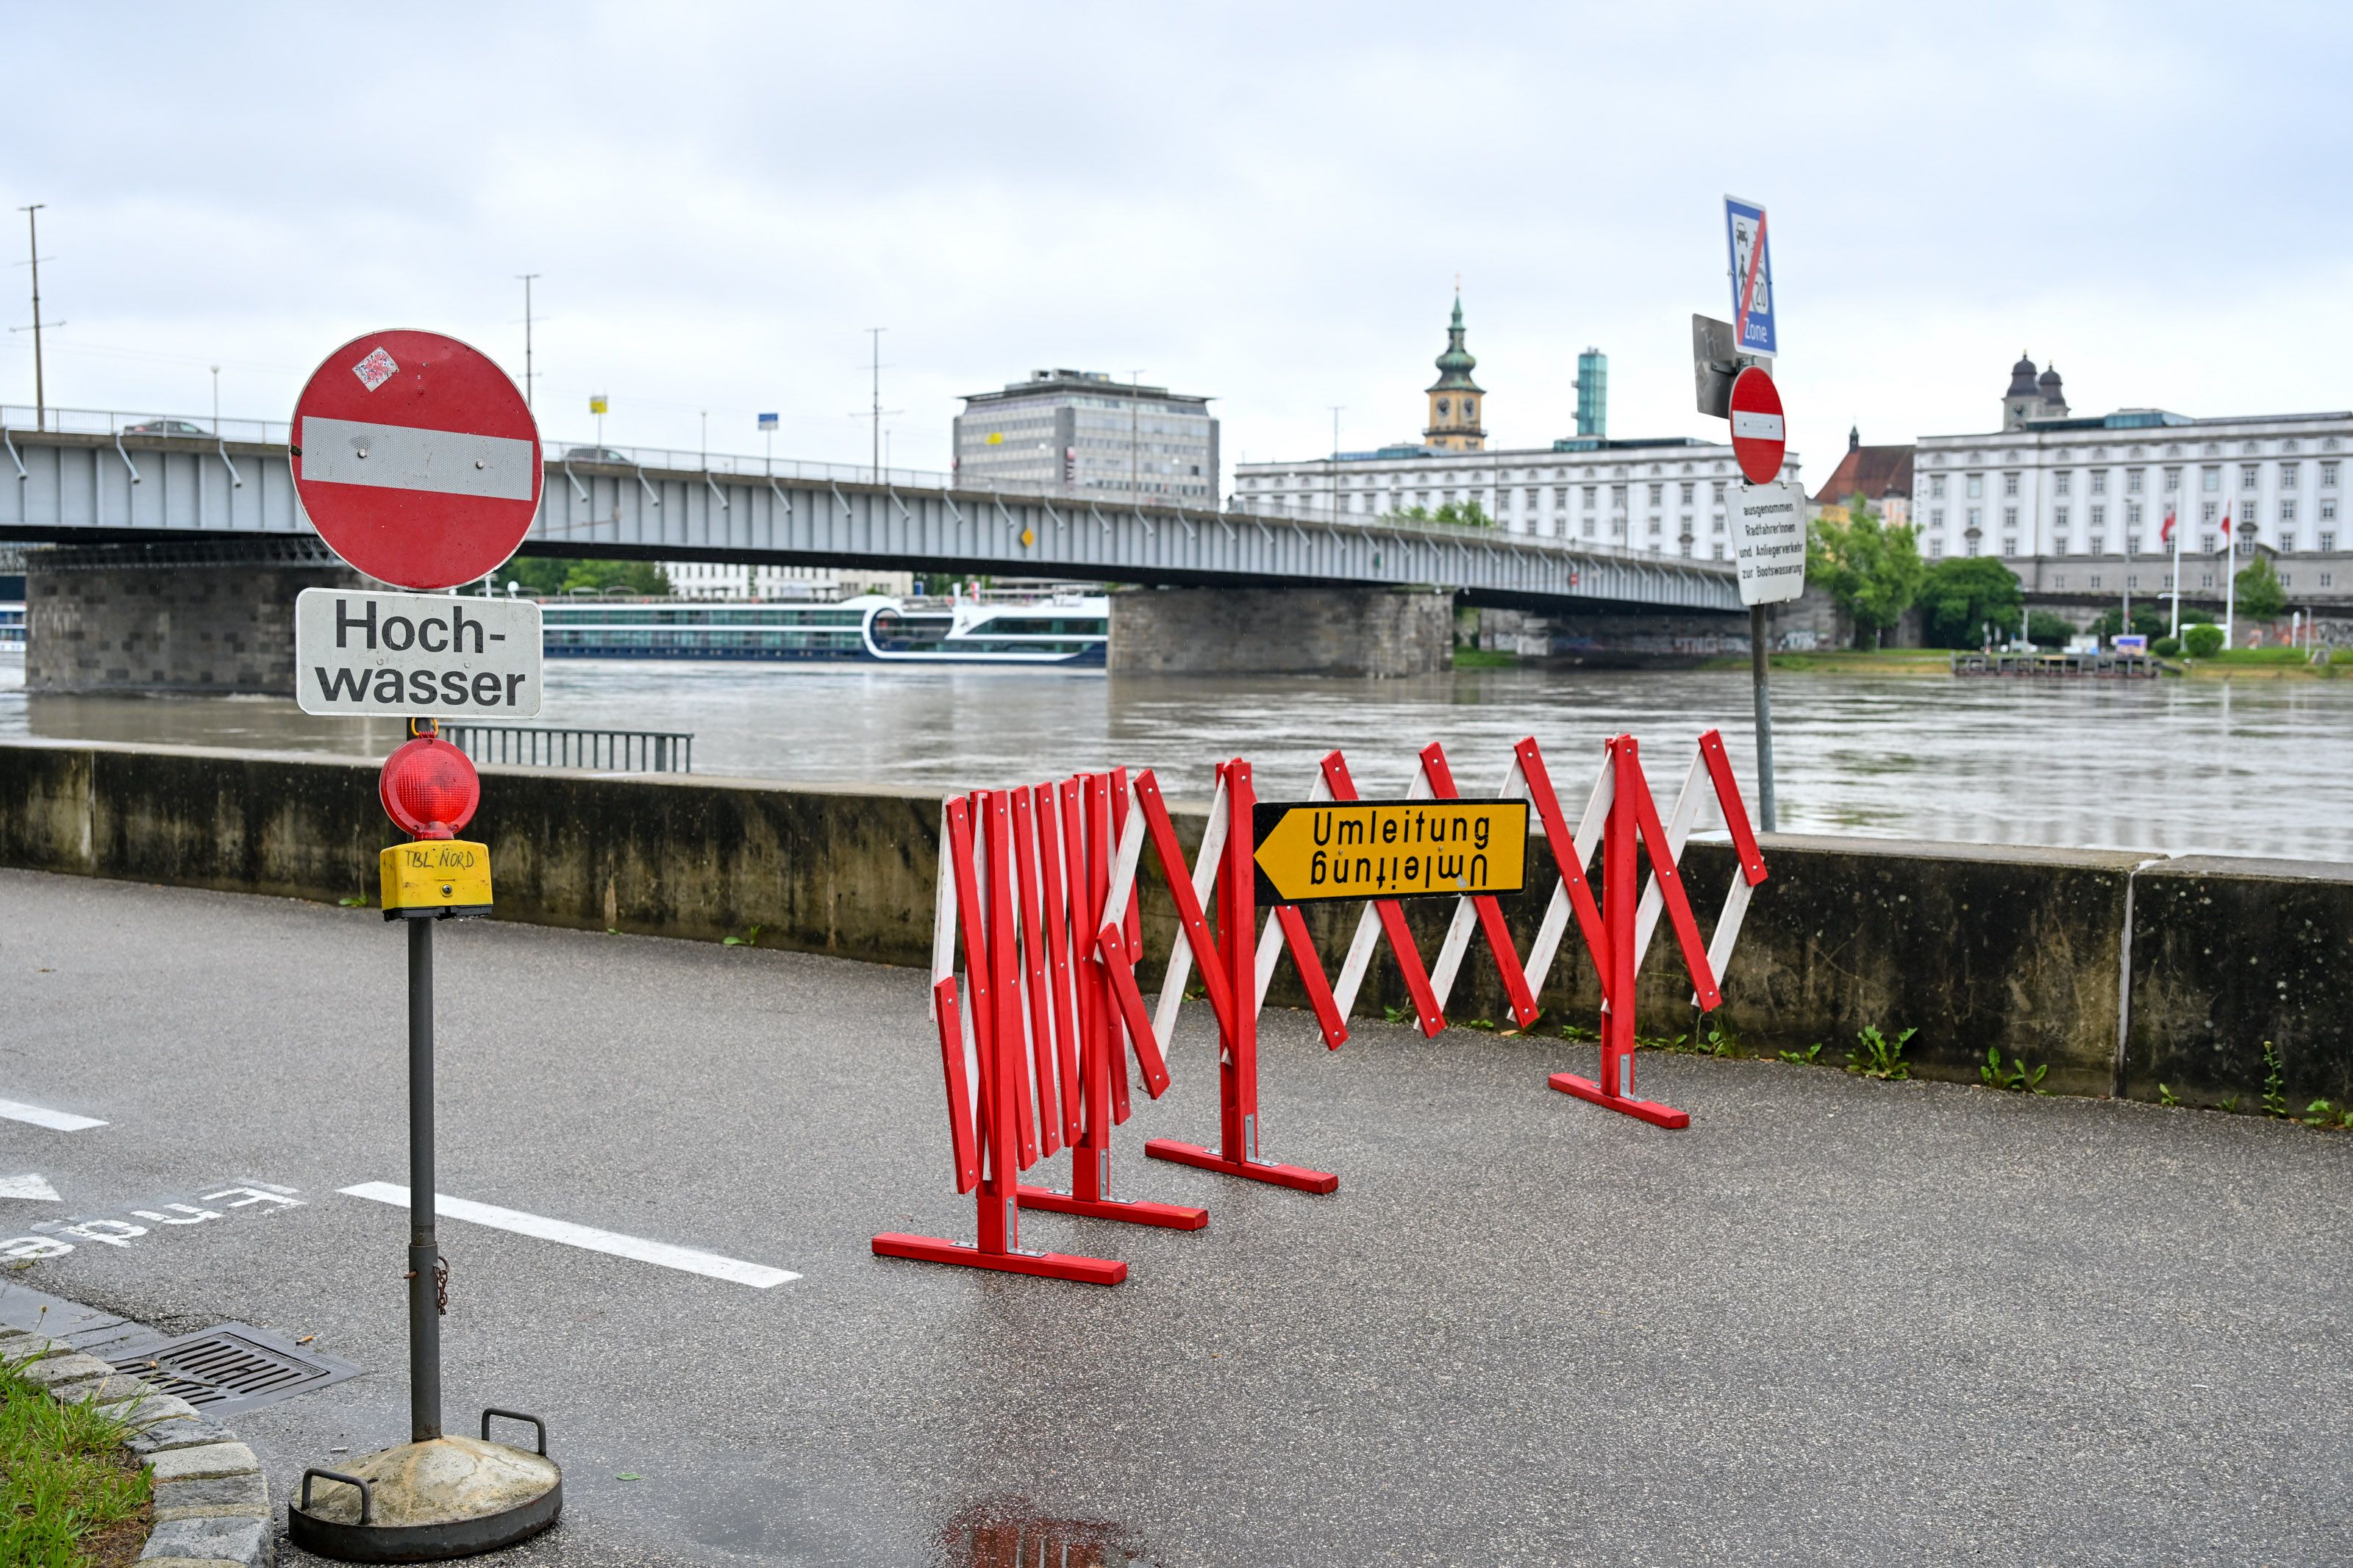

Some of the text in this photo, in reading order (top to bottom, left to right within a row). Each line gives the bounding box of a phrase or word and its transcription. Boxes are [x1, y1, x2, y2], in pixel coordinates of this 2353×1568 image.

[1755, 282, 1767, 307] 20
[1744, 318, 1768, 343] Zone
[1743, 503, 1794, 518] ausgenommen
[1745, 522, 1796, 537] RadfahrerInnen
[1739, 541, 1803, 559] und Anliegerverkehr
[1742, 564, 1803, 579] zur Bootswasserung
[335, 598, 506, 654] Hoch-
[314, 666, 525, 707] wasser
[1313, 809, 1490, 851] Umleitung
[405, 850, 475, 870] TBL NORD
[1310, 850, 1488, 890] Umleitung
